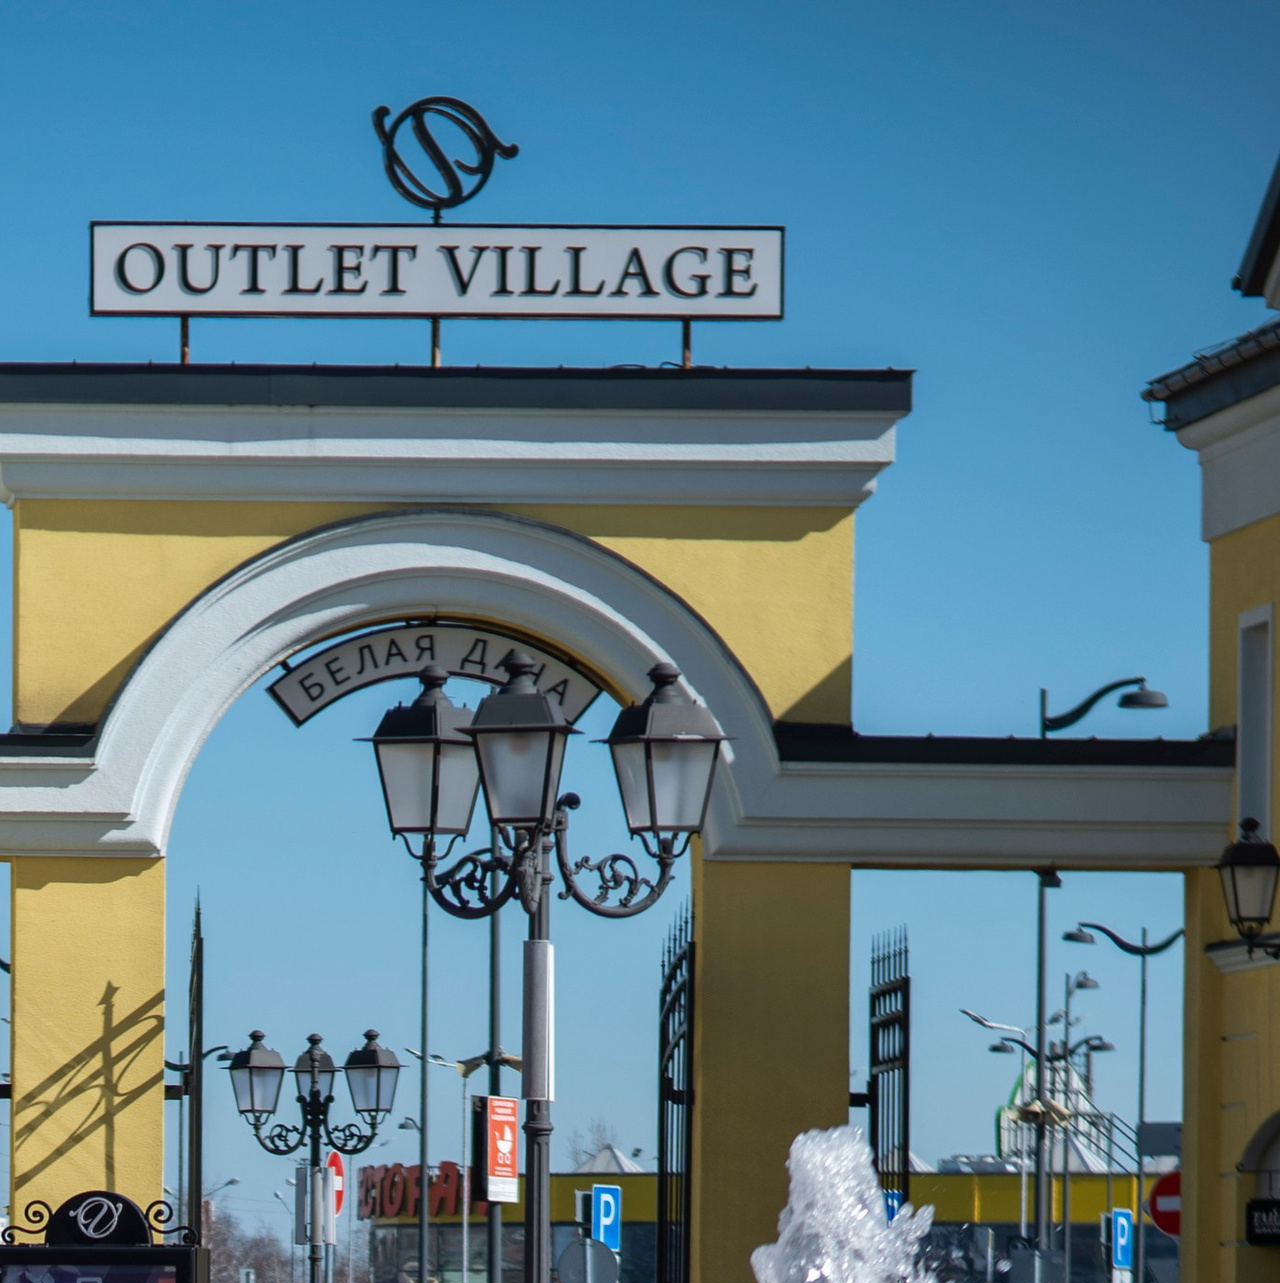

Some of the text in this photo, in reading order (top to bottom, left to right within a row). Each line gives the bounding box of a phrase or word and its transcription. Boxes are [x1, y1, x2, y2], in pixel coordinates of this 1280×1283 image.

[113, 242, 759, 299] OUTLET VILLAGE
[298, 634, 436, 703] БЕЛАЯ
